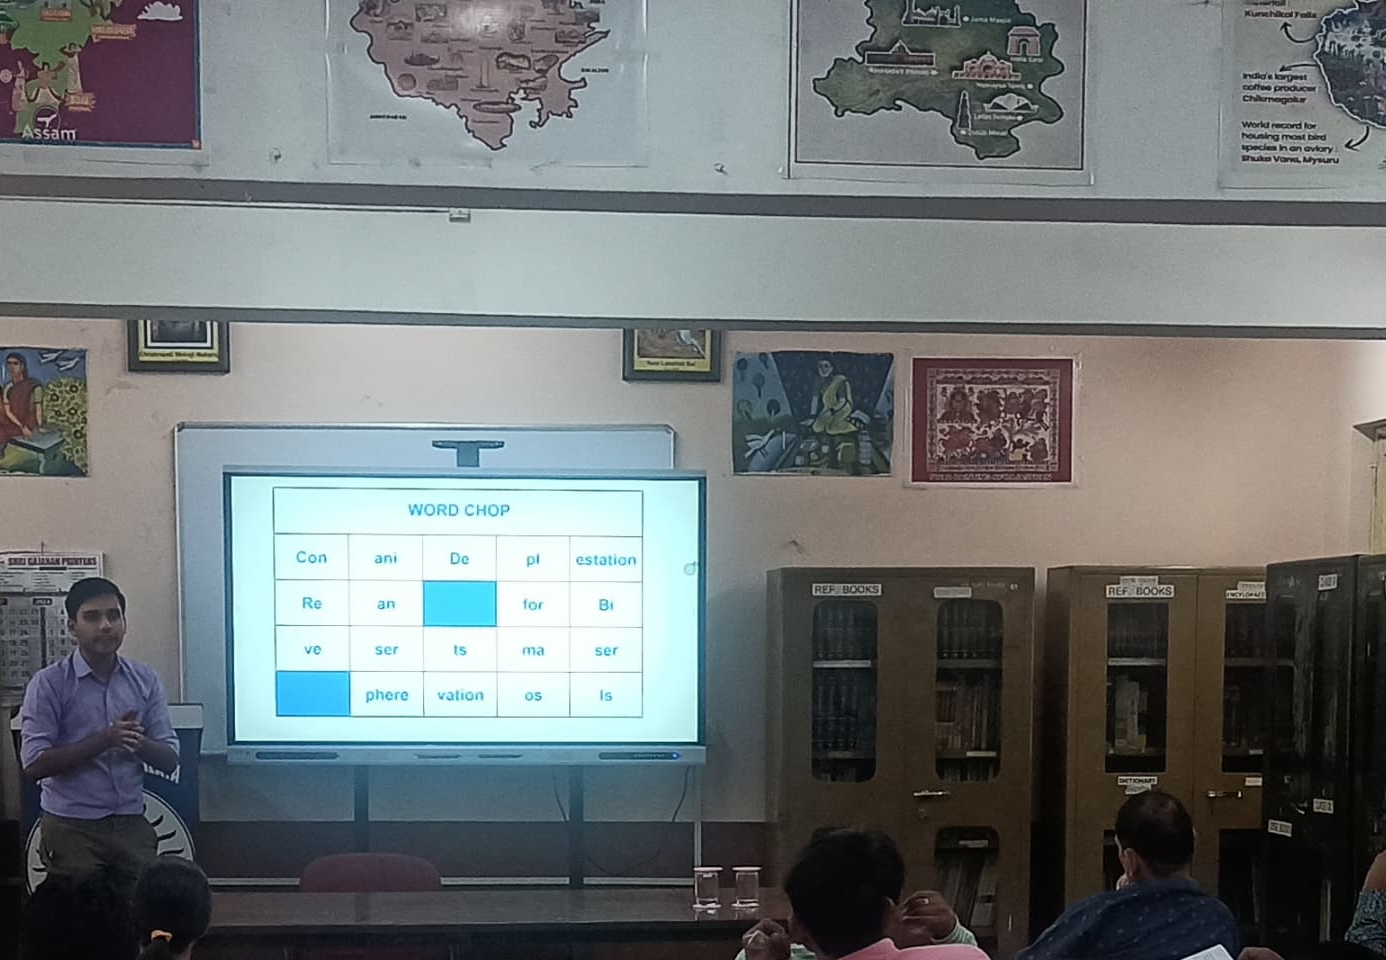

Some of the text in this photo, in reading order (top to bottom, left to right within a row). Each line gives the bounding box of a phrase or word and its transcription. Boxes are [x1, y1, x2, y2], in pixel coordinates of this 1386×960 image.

[21, 124, 77, 141] Assam
[408, 503, 511, 517] WORD CHOP
[296, 551, 328, 565] Con
[374, 551, 398, 565] ani
[449, 552, 470, 566] De
[576, 553, 638, 568] estation
[843, 585, 879, 594] BOOKS
[1136, 587, 1172, 596] BOOKS
[301, 597, 614, 612] Re an for Bi
[303, 644, 619, 657] ve ser ts ma ser
[365, 688, 409, 705] phere
[437, 688, 484, 702] vation
[524, 690, 542, 702] os
